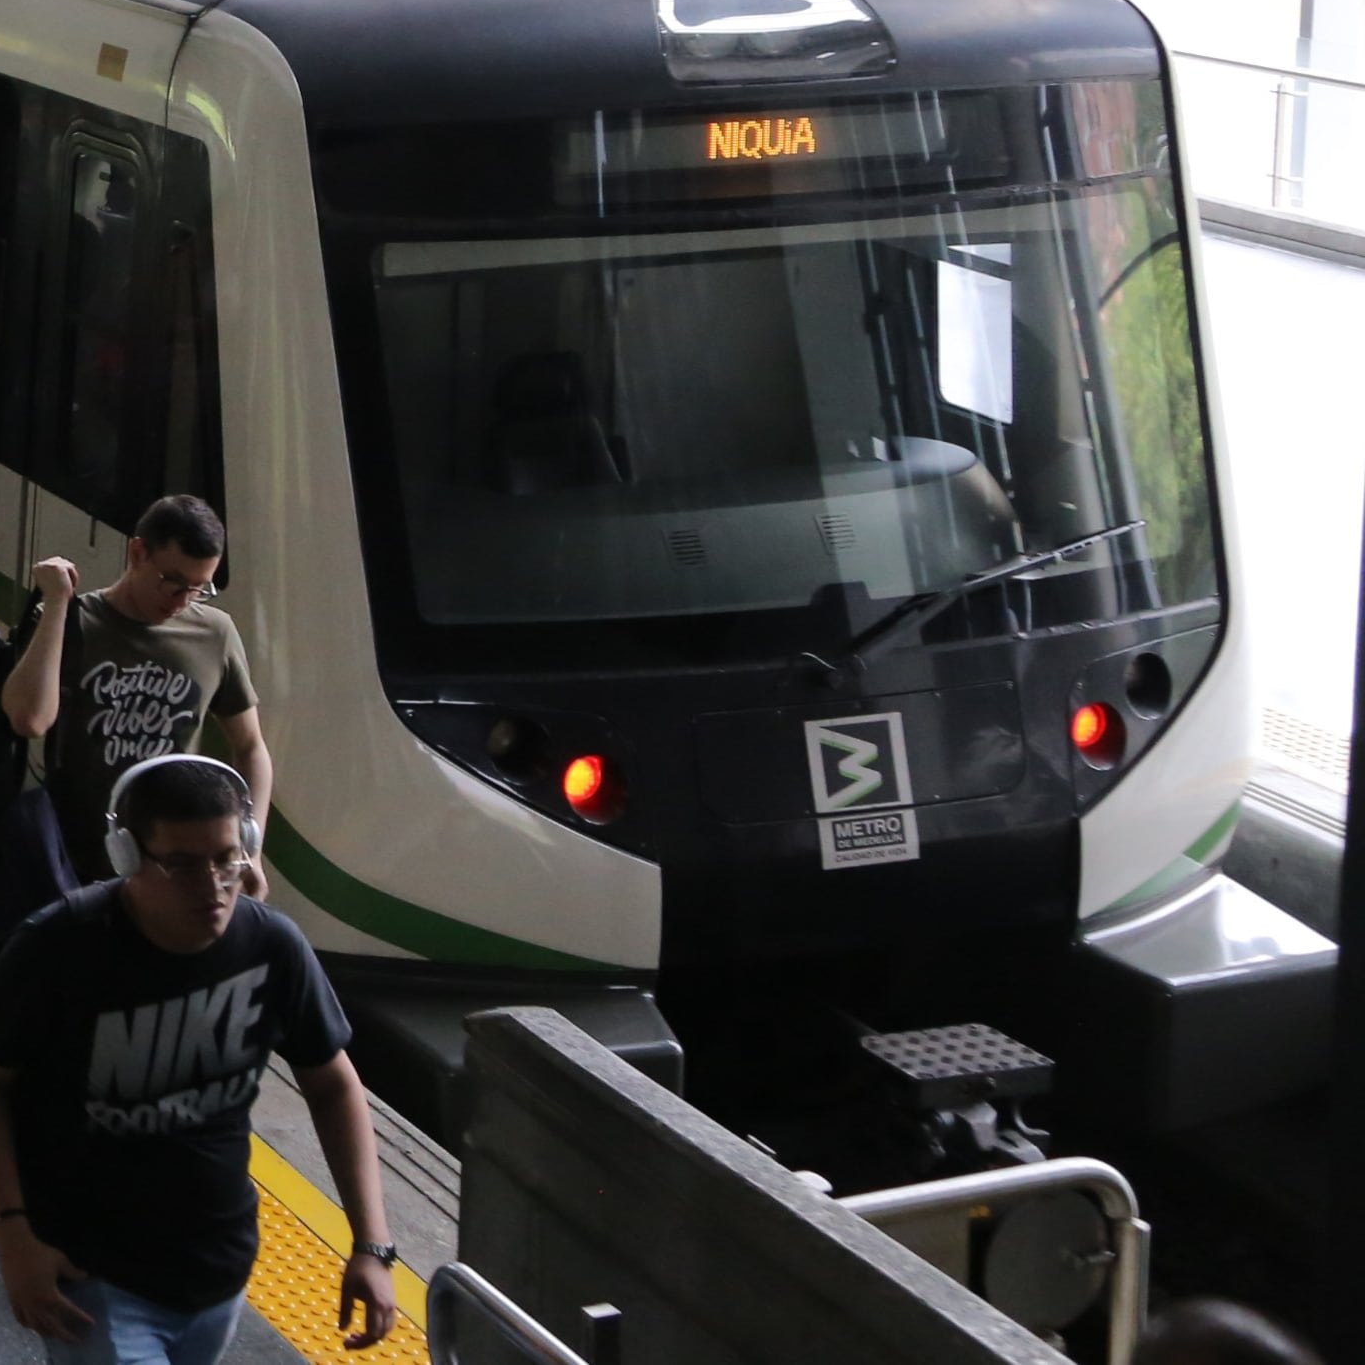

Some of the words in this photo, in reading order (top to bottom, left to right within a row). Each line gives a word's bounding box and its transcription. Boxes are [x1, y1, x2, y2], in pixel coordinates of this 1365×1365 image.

[80, 660, 191, 705] Positive
[835, 816, 901, 838] METRO
[837, 839, 853, 849] DE
[87, 962, 270, 1101] NIKE
